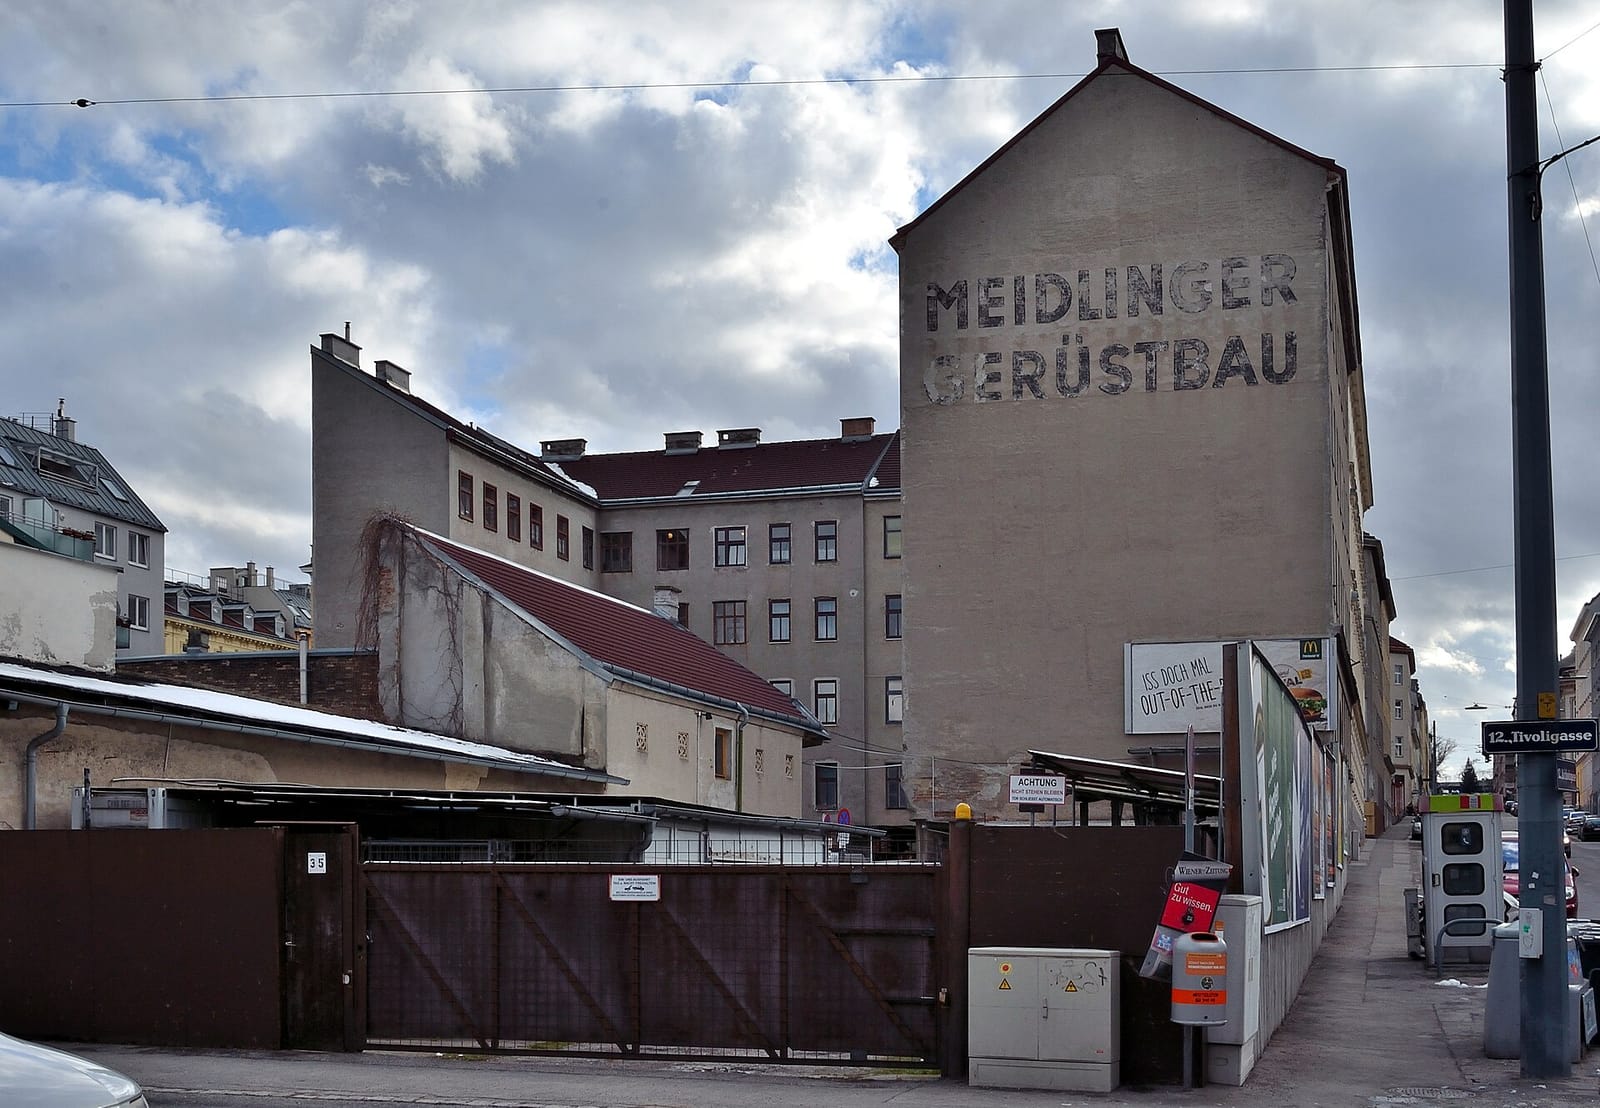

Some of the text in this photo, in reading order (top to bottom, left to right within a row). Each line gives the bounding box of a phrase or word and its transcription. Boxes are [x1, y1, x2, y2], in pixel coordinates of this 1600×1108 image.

[926, 253, 1298, 332] MEIDLINGER
[922, 331, 1298, 405] GERÜSTBAU
[1142, 656, 1213, 692] ISS DOCH MAL
[1018, 778, 1057, 787] ACHTUNG
[310, 858, 324, 868] 35
[1174, 882, 1190, 896] Gut
[1171, 893, 1213, 913] zu wissen.
